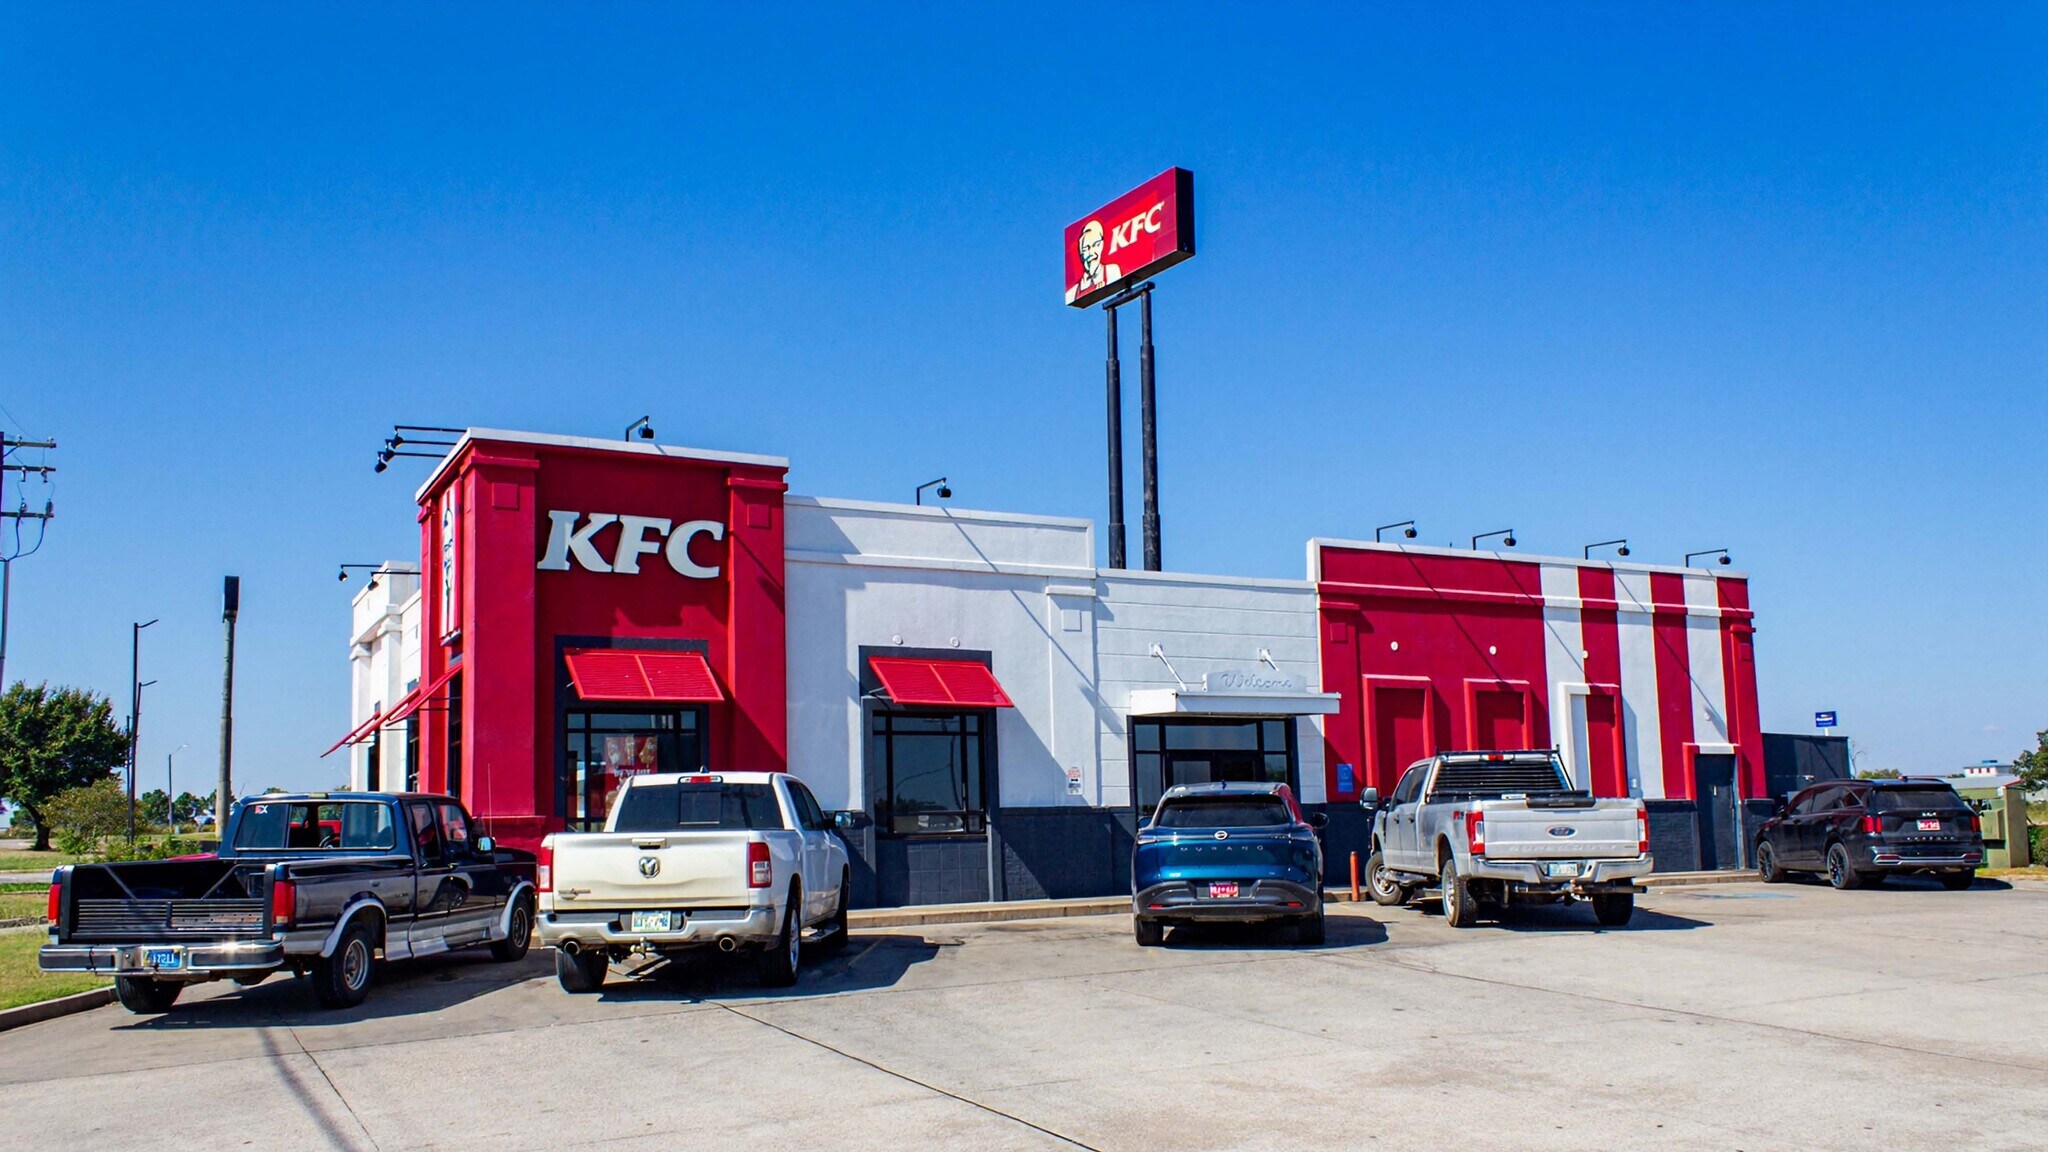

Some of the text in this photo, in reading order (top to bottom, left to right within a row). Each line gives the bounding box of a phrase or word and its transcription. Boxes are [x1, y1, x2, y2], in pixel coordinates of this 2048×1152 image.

[1108, 200, 1165, 255] KFC
[536, 509, 725, 580] KFC
[1180, 844, 1264, 853] MURANO
